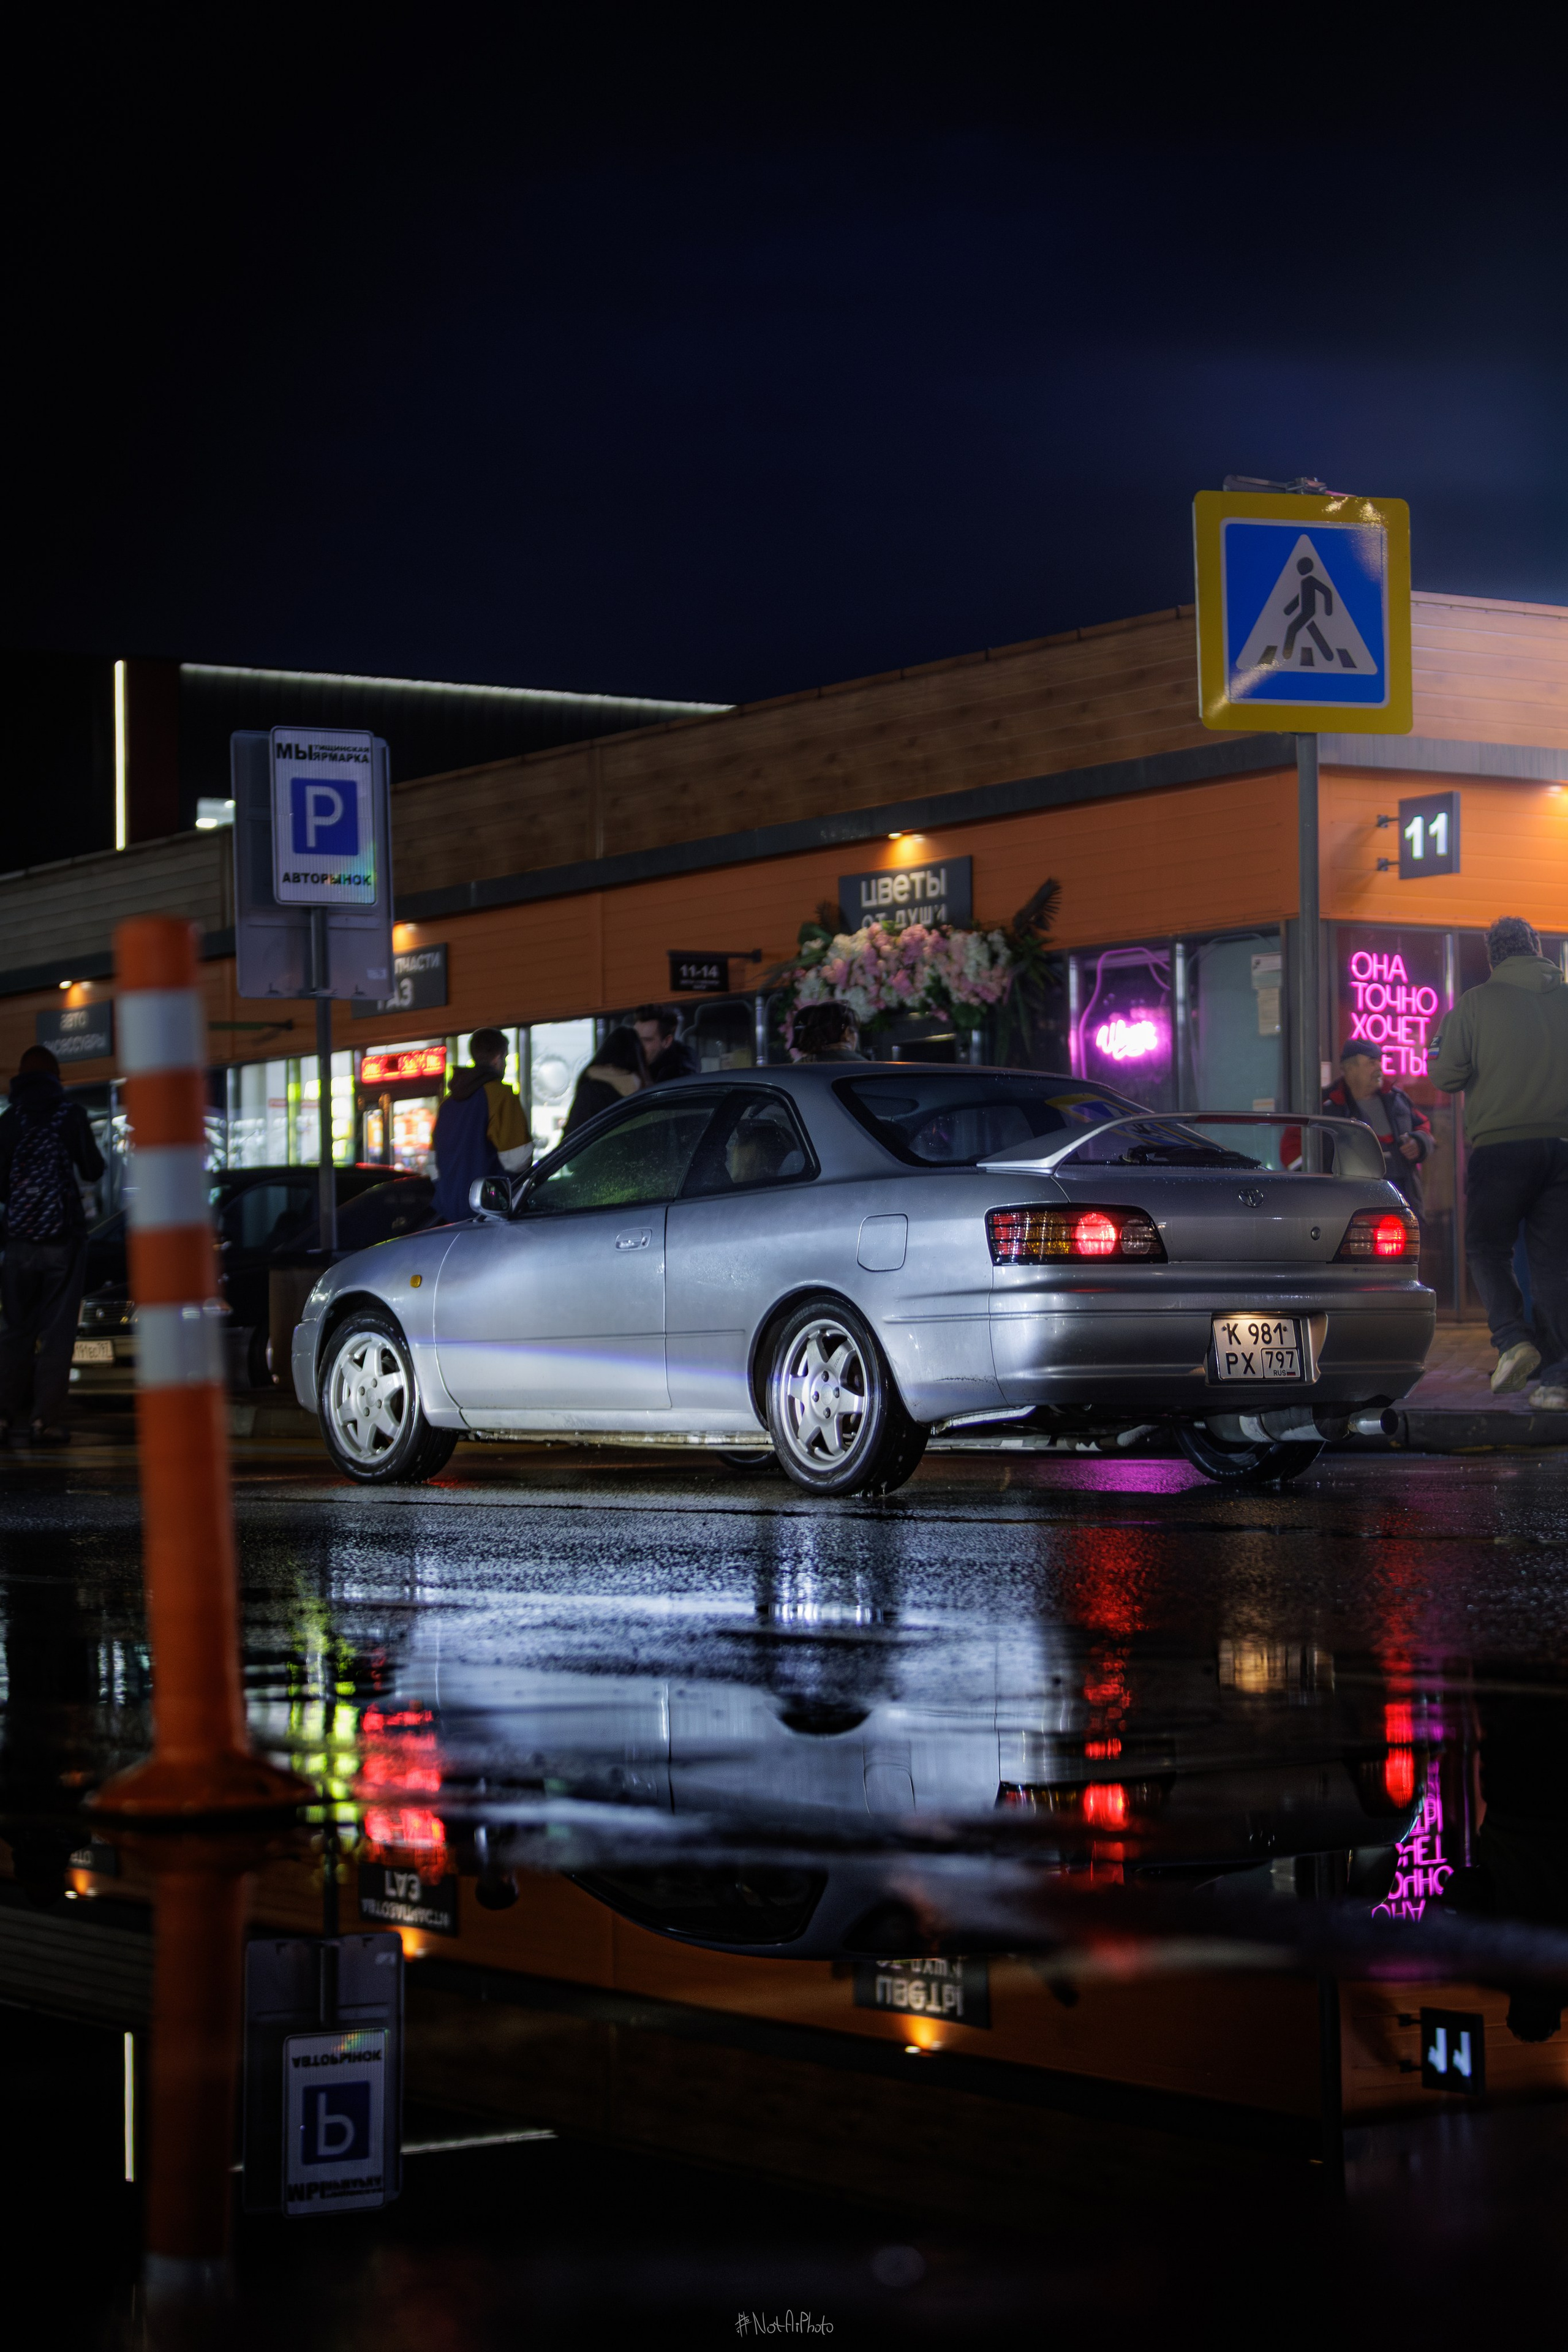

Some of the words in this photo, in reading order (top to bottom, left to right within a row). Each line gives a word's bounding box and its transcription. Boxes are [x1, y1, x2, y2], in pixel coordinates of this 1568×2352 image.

[277, 743, 312, 760] МЫ
[313, 752, 370, 763] ЯРМАРКА
[1404, 812, 1449, 861] 11
[282, 872, 371, 886] АВТОРЫНОК
[679, 963, 720, 978] 11-14
[1351, 951, 1408, 984] ОНА
[1350, 981, 1439, 1016] ТОЧНО
[1351, 1012, 1431, 1046] ХОЧЕТ
[1248, 1322, 1284, 1344] 981
[1265, 1351, 1294, 1368] 797
